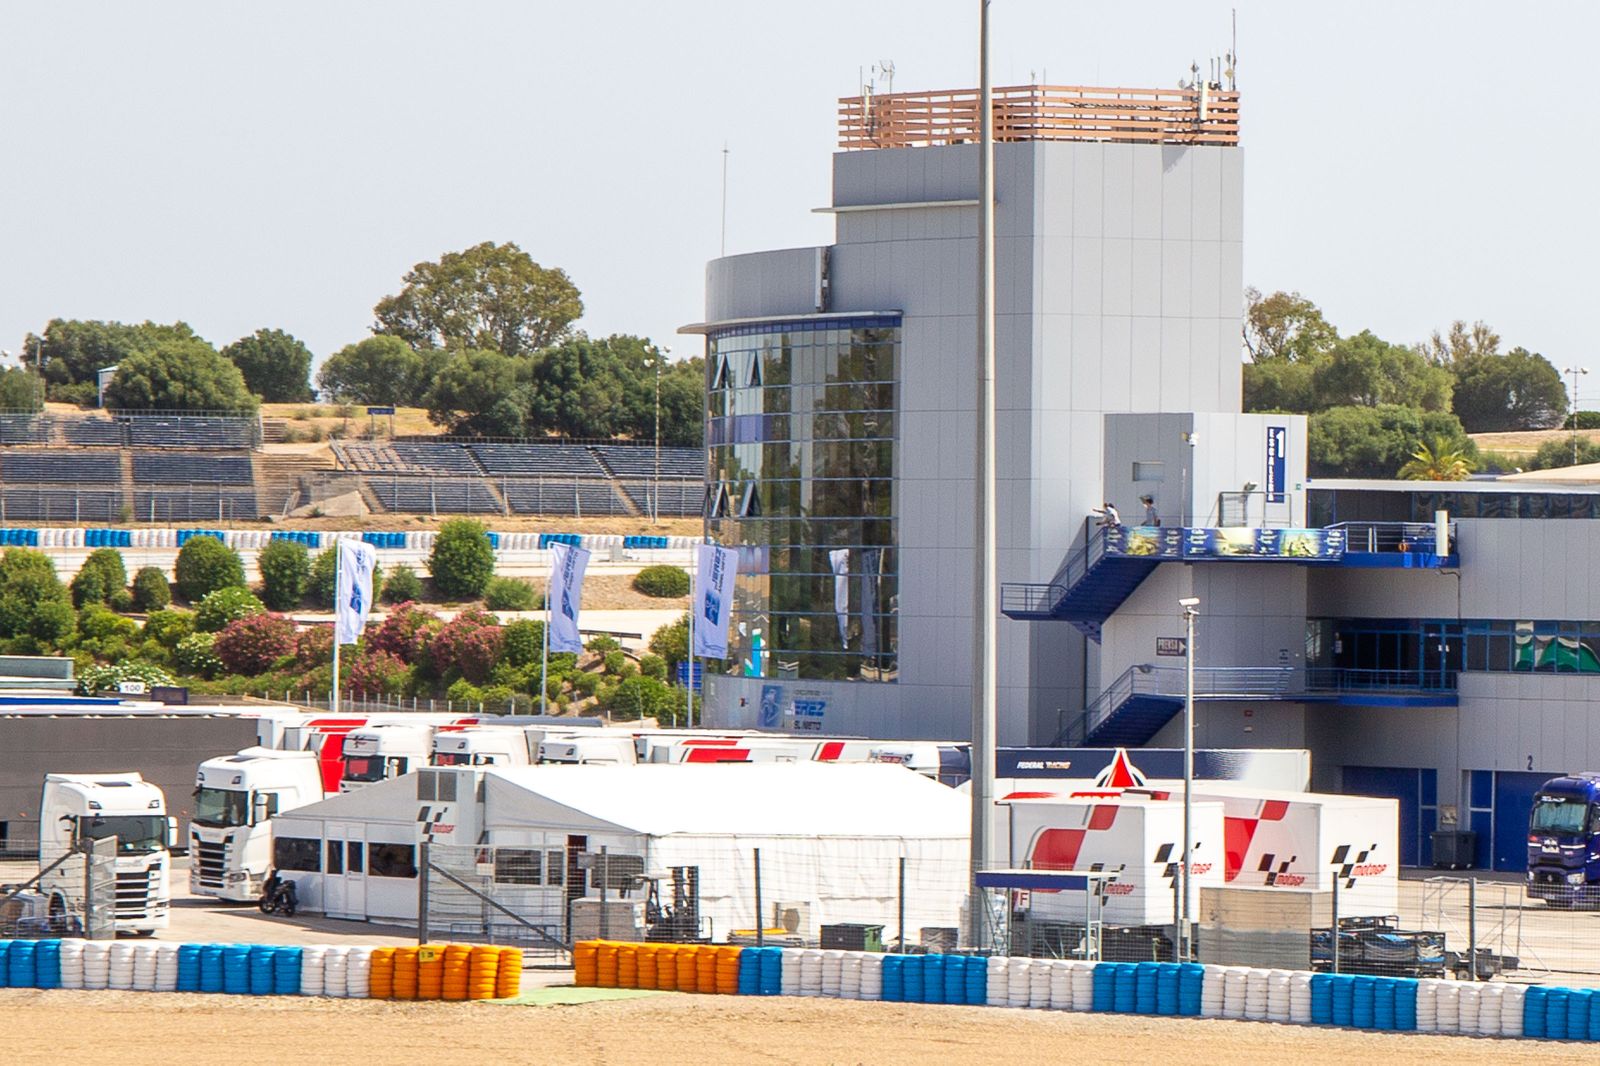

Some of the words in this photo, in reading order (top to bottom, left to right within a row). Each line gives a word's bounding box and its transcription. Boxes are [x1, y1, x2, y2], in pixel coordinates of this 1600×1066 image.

[1276, 430, 1285, 459] 1
[1267, 428, 1275, 501] ESCALERA
[1526, 755, 1534, 771] 2
[1020, 892, 1029, 906] F
